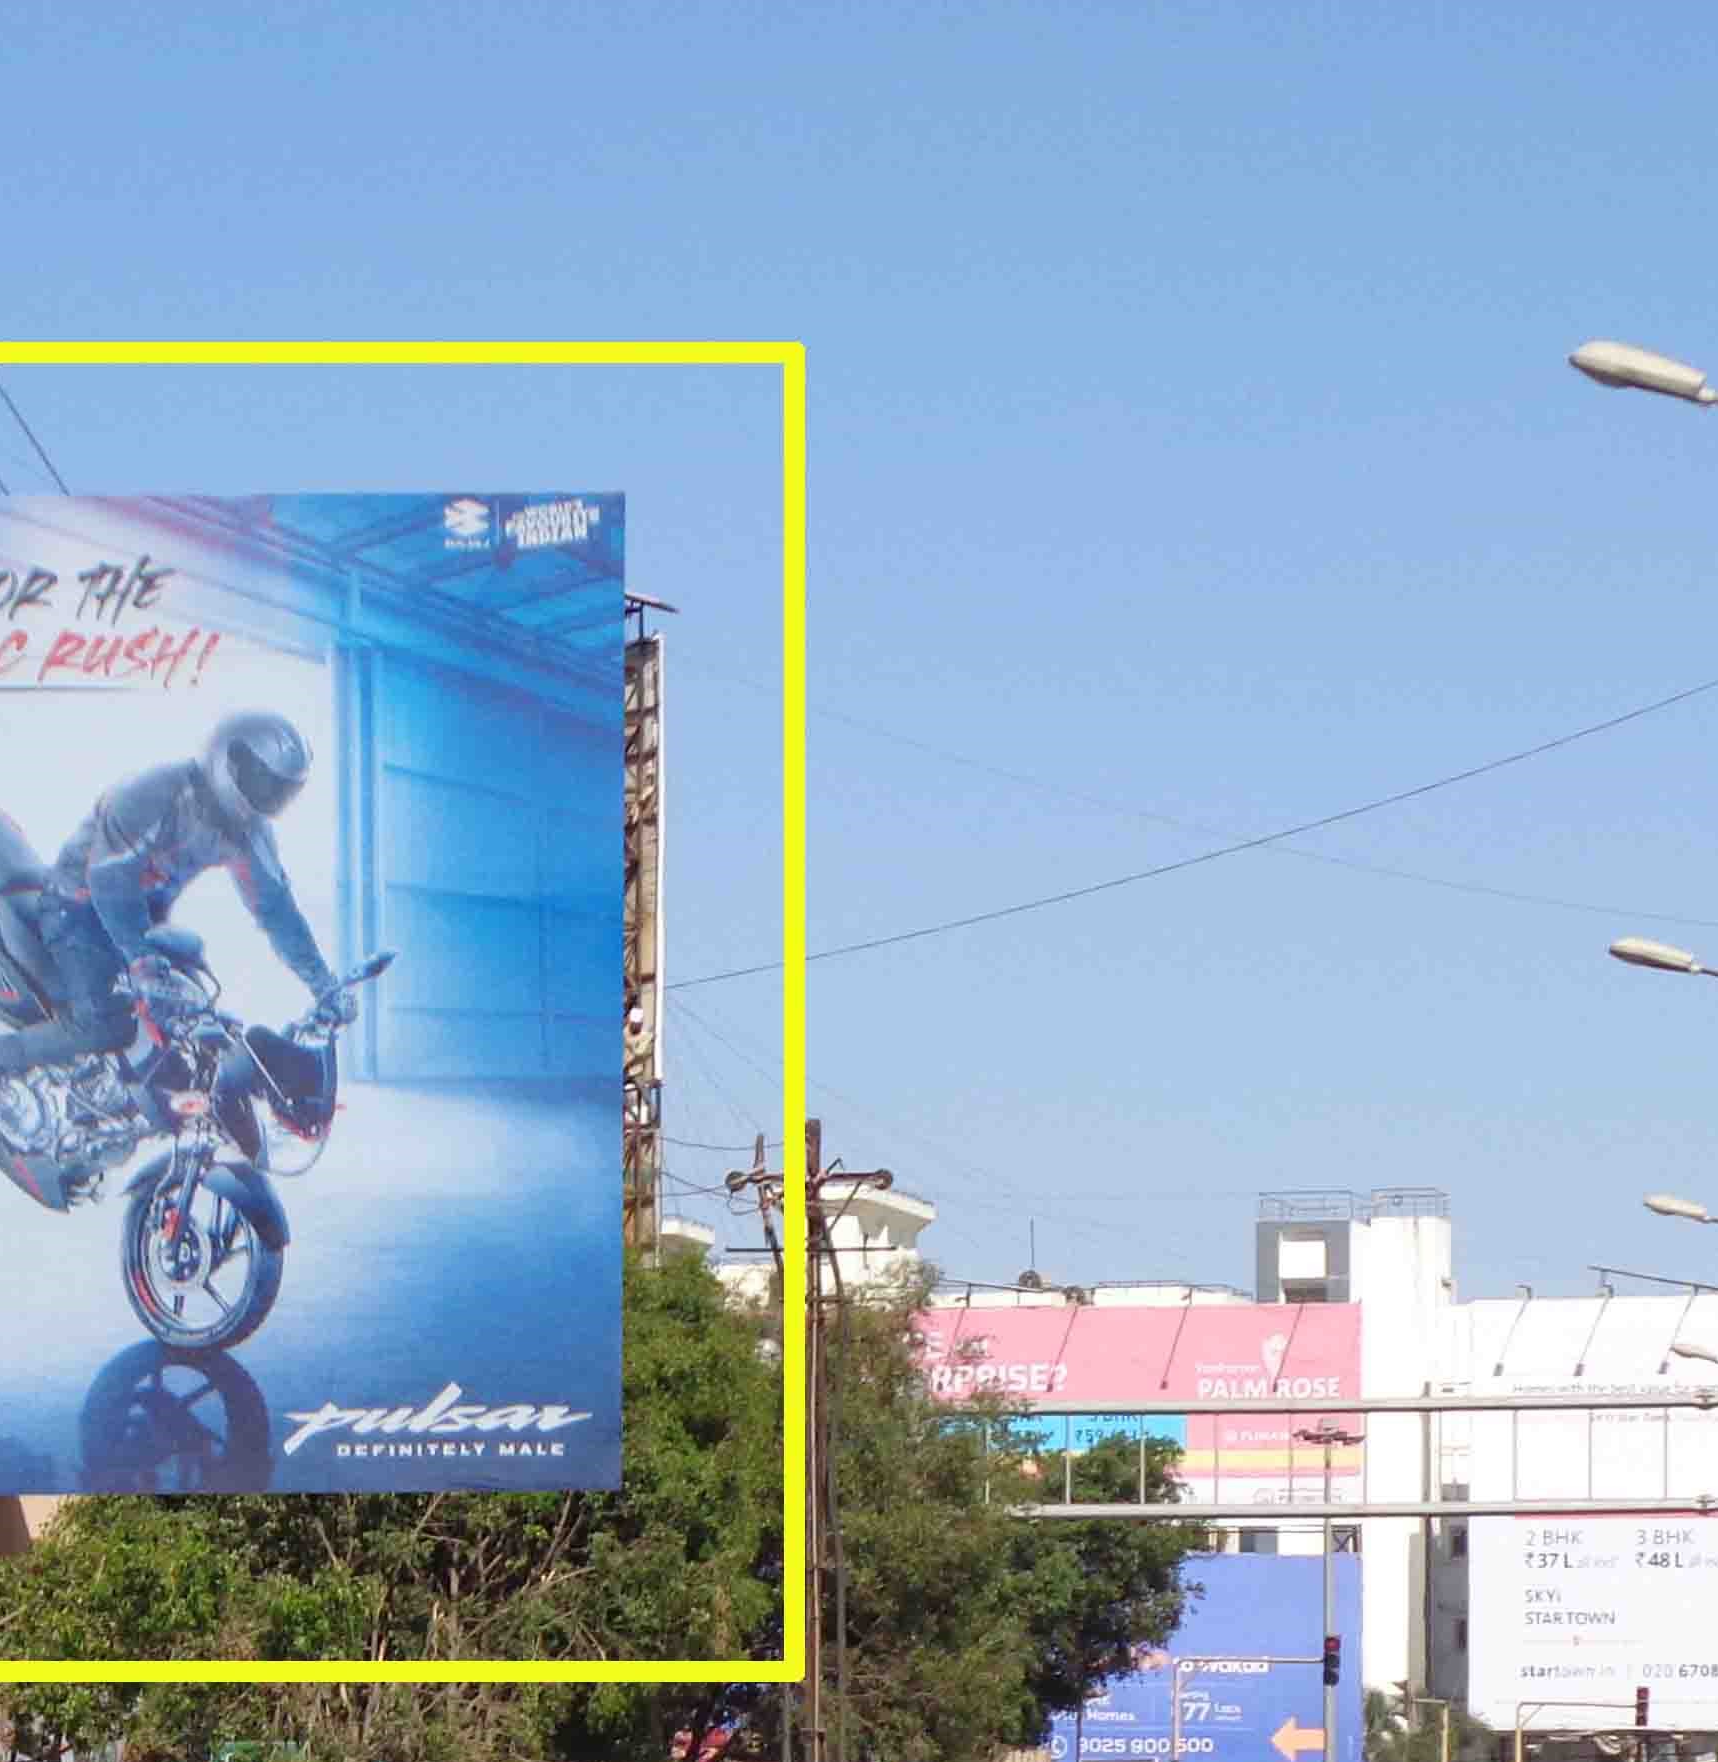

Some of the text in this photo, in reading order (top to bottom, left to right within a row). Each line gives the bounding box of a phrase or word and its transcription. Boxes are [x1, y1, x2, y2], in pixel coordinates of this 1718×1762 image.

[78, 555, 175, 627] THE
[37, 626, 220, 691] RUSH!
[1197, 1375, 1340, 1399] PALM ROSE
[284, 1381, 592, 1456] pulsar
[337, 1441, 564, 1457] DEFINITELY MALE
[1526, 1530, 1584, 1546] 2 BHK
[1637, 1529, 1695, 1545] 3 BHK
[1183, 1701, 1211, 1721] 77
